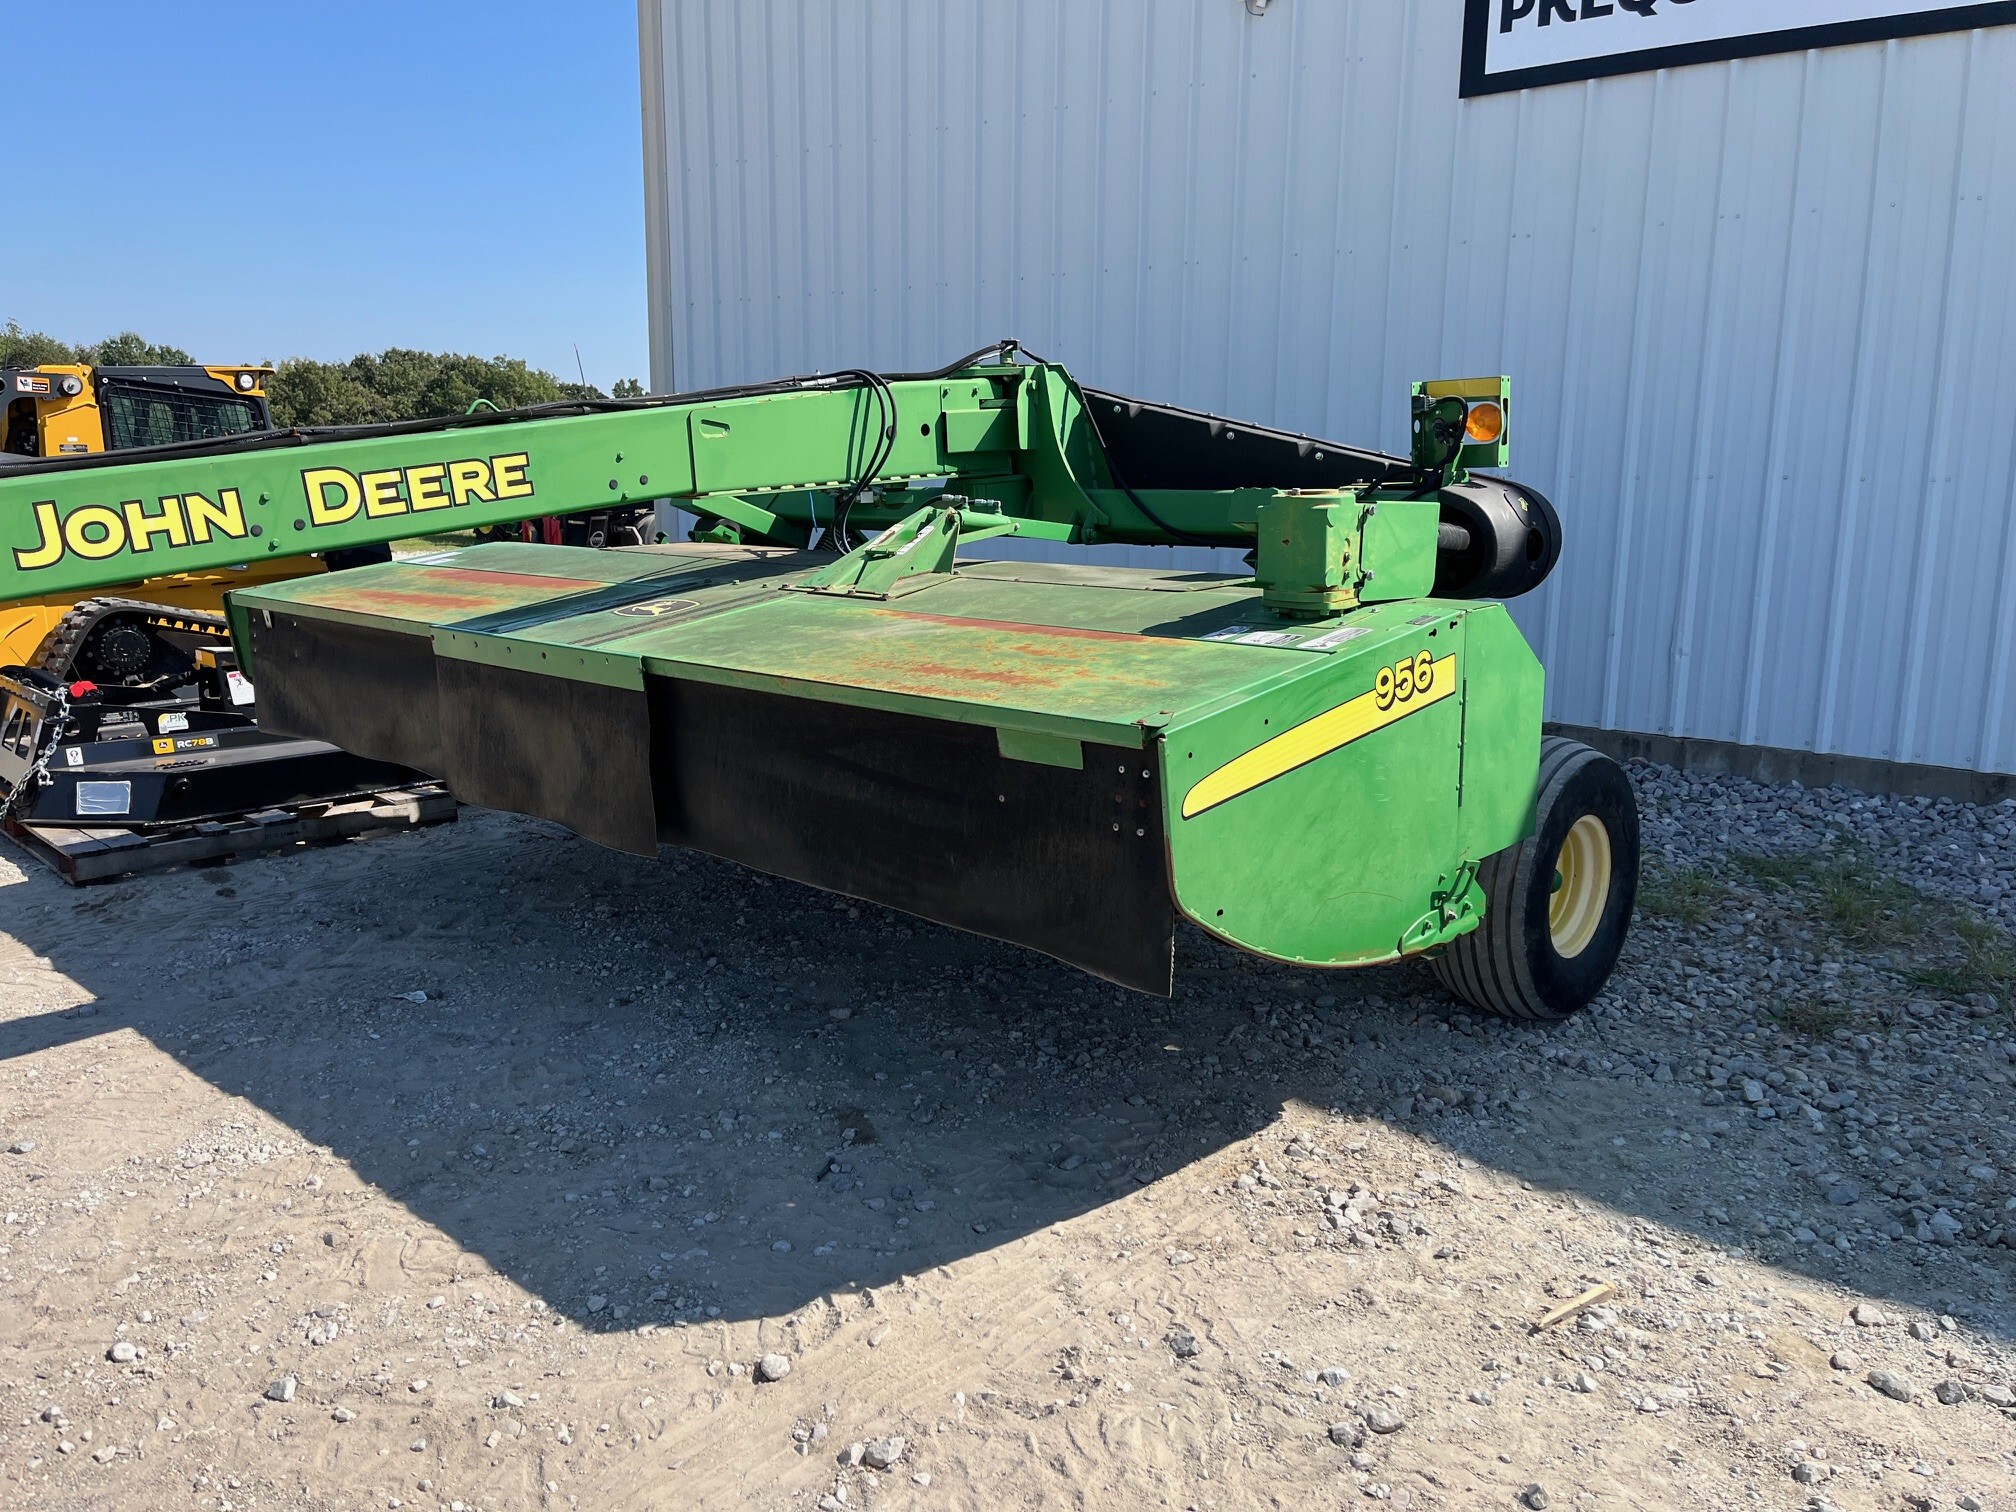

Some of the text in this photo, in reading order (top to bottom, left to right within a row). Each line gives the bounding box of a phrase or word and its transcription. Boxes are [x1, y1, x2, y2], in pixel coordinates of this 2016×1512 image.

[12, 451, 535, 571] JOHN DEERE
[1375, 649, 1434, 711] 956
[176, 737, 214, 749] RC78B
